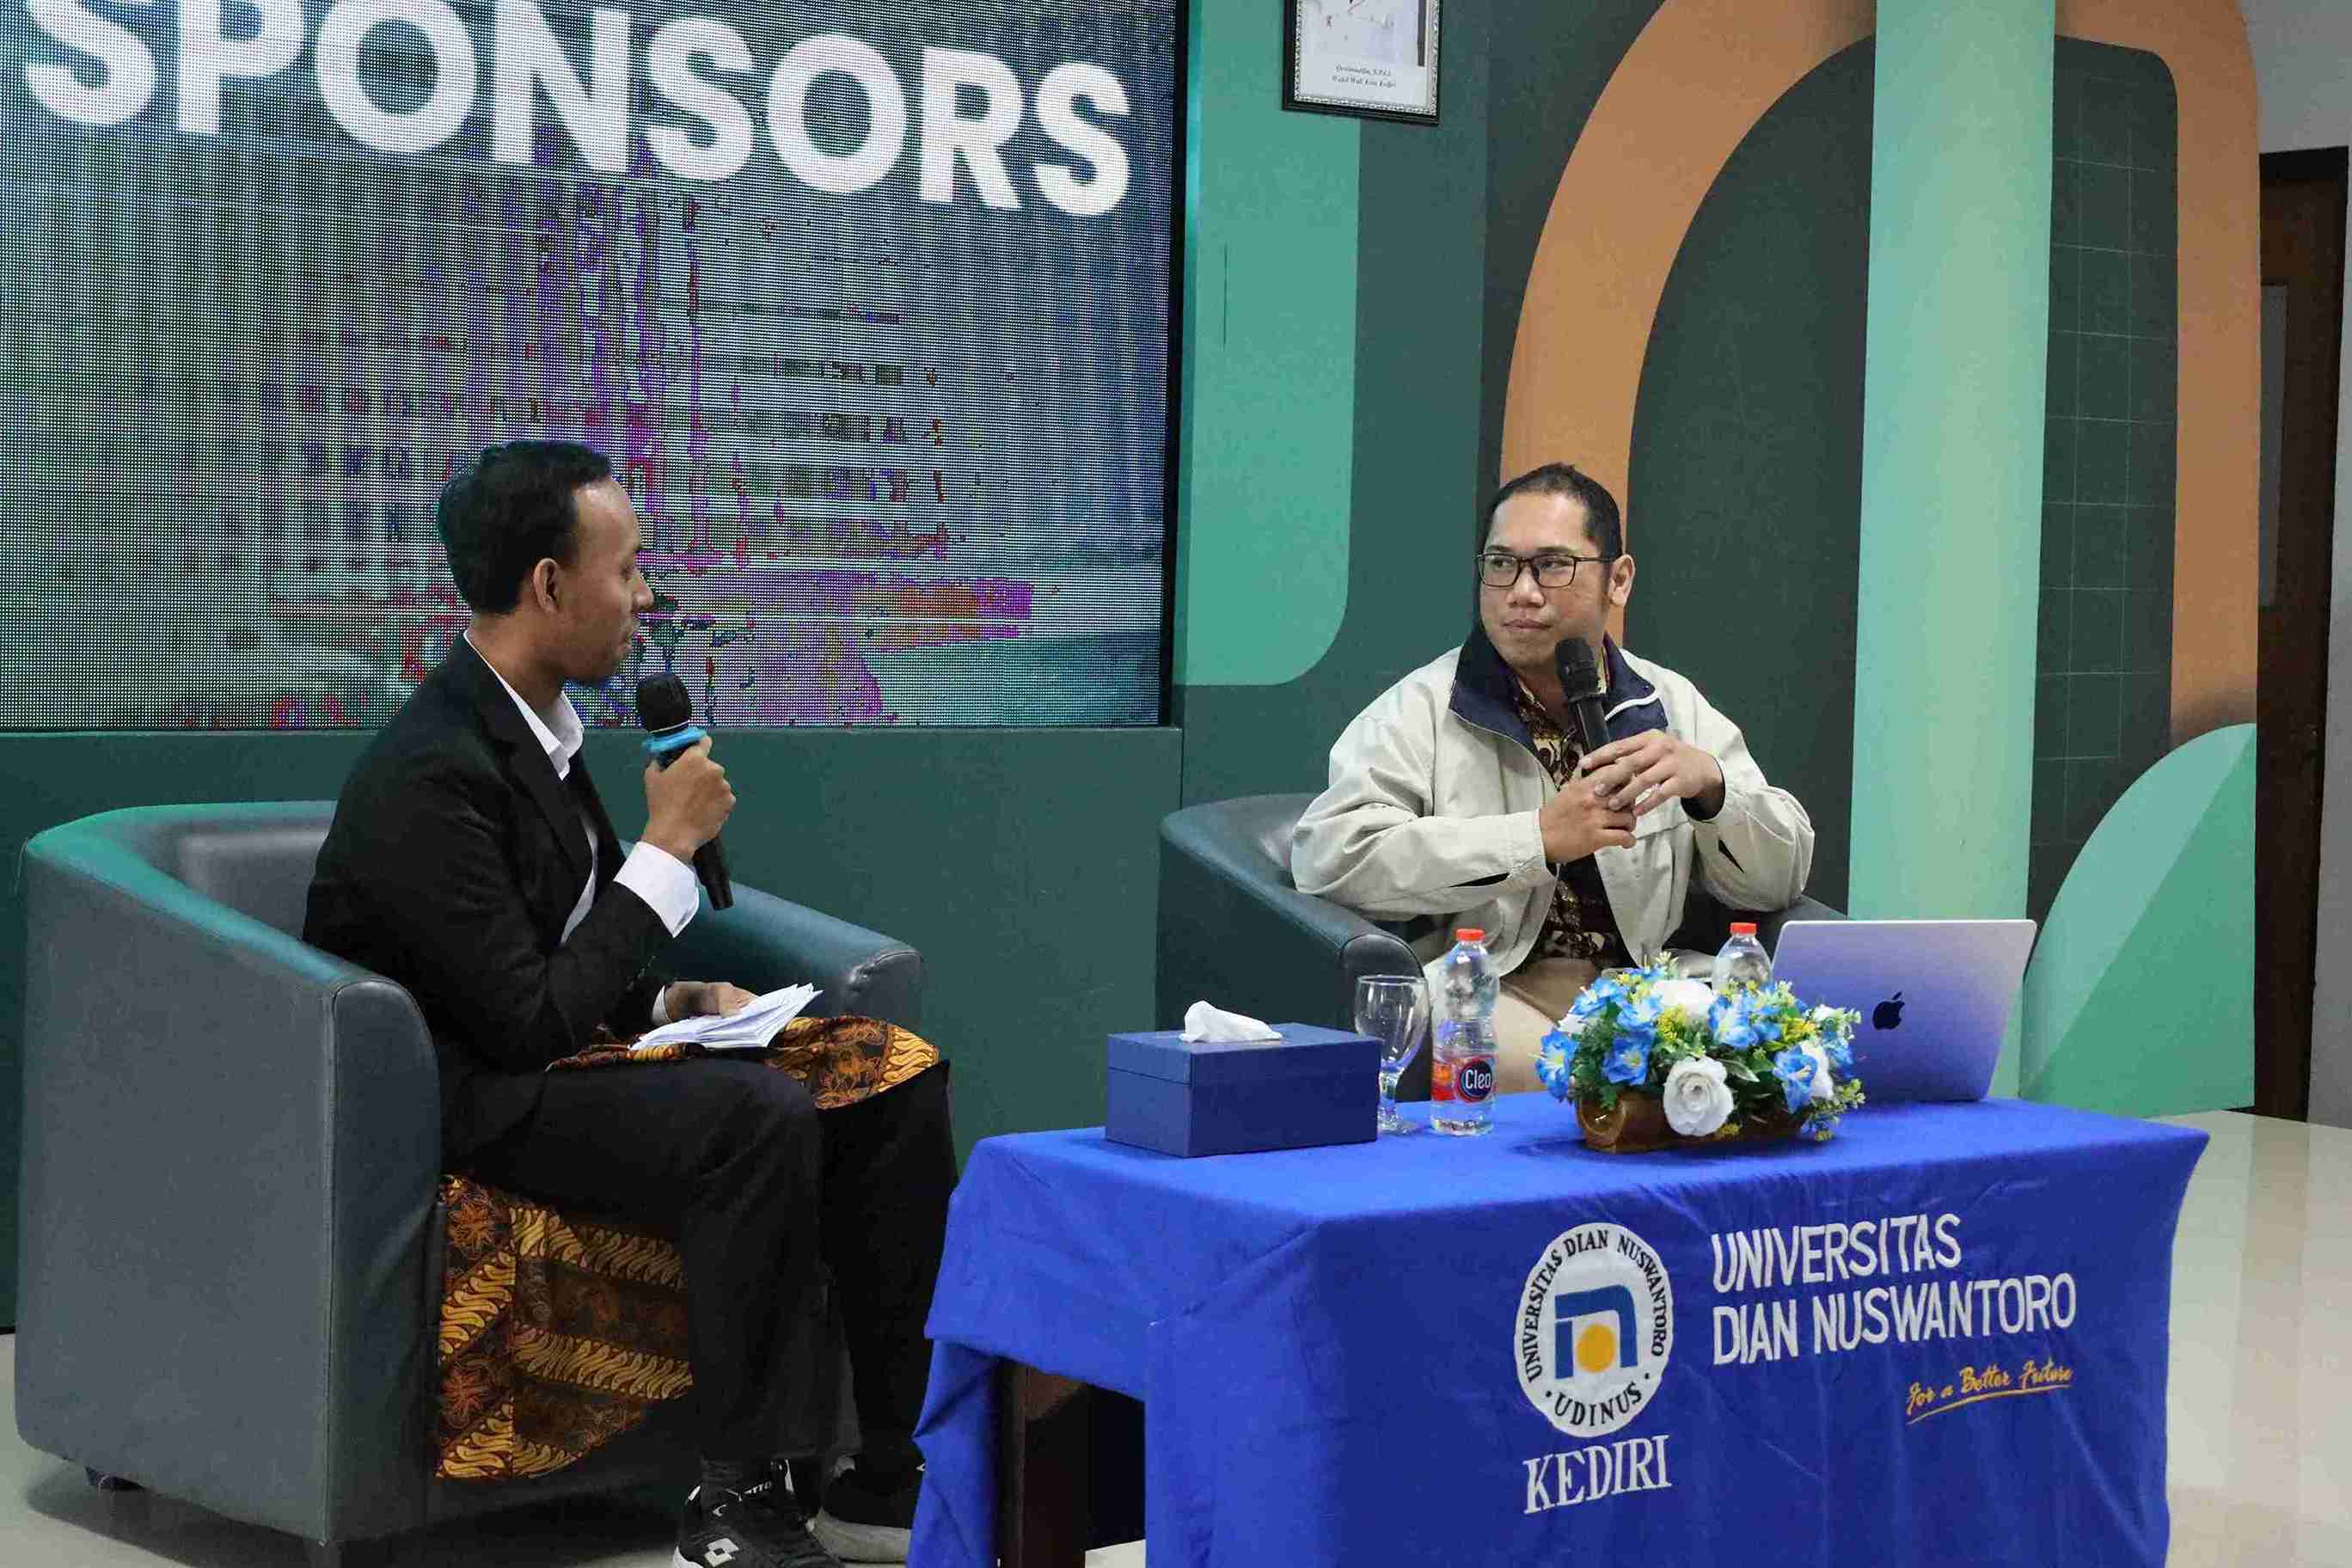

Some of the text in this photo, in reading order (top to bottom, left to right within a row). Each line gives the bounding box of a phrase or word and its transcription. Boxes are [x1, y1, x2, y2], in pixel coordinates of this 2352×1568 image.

[24, 0, 1130, 217] SPONSORS
[1465, 1069, 1491, 1089] Cleo
[1711, 1213, 1962, 1293] UNIVERSITAS
[1522, 1229, 1667, 1382] UNIVERSITAS DIAN NUSWANTORO
[1712, 1272, 2077, 1365] DIAN NUSWANTORO
[1554, 1381, 1643, 1427] UDINUS
[1959, 1364, 2012, 1393] Better
[2019, 1358, 2073, 1390] Future
[1522, 1435, 1673, 1515] KEDIRI
